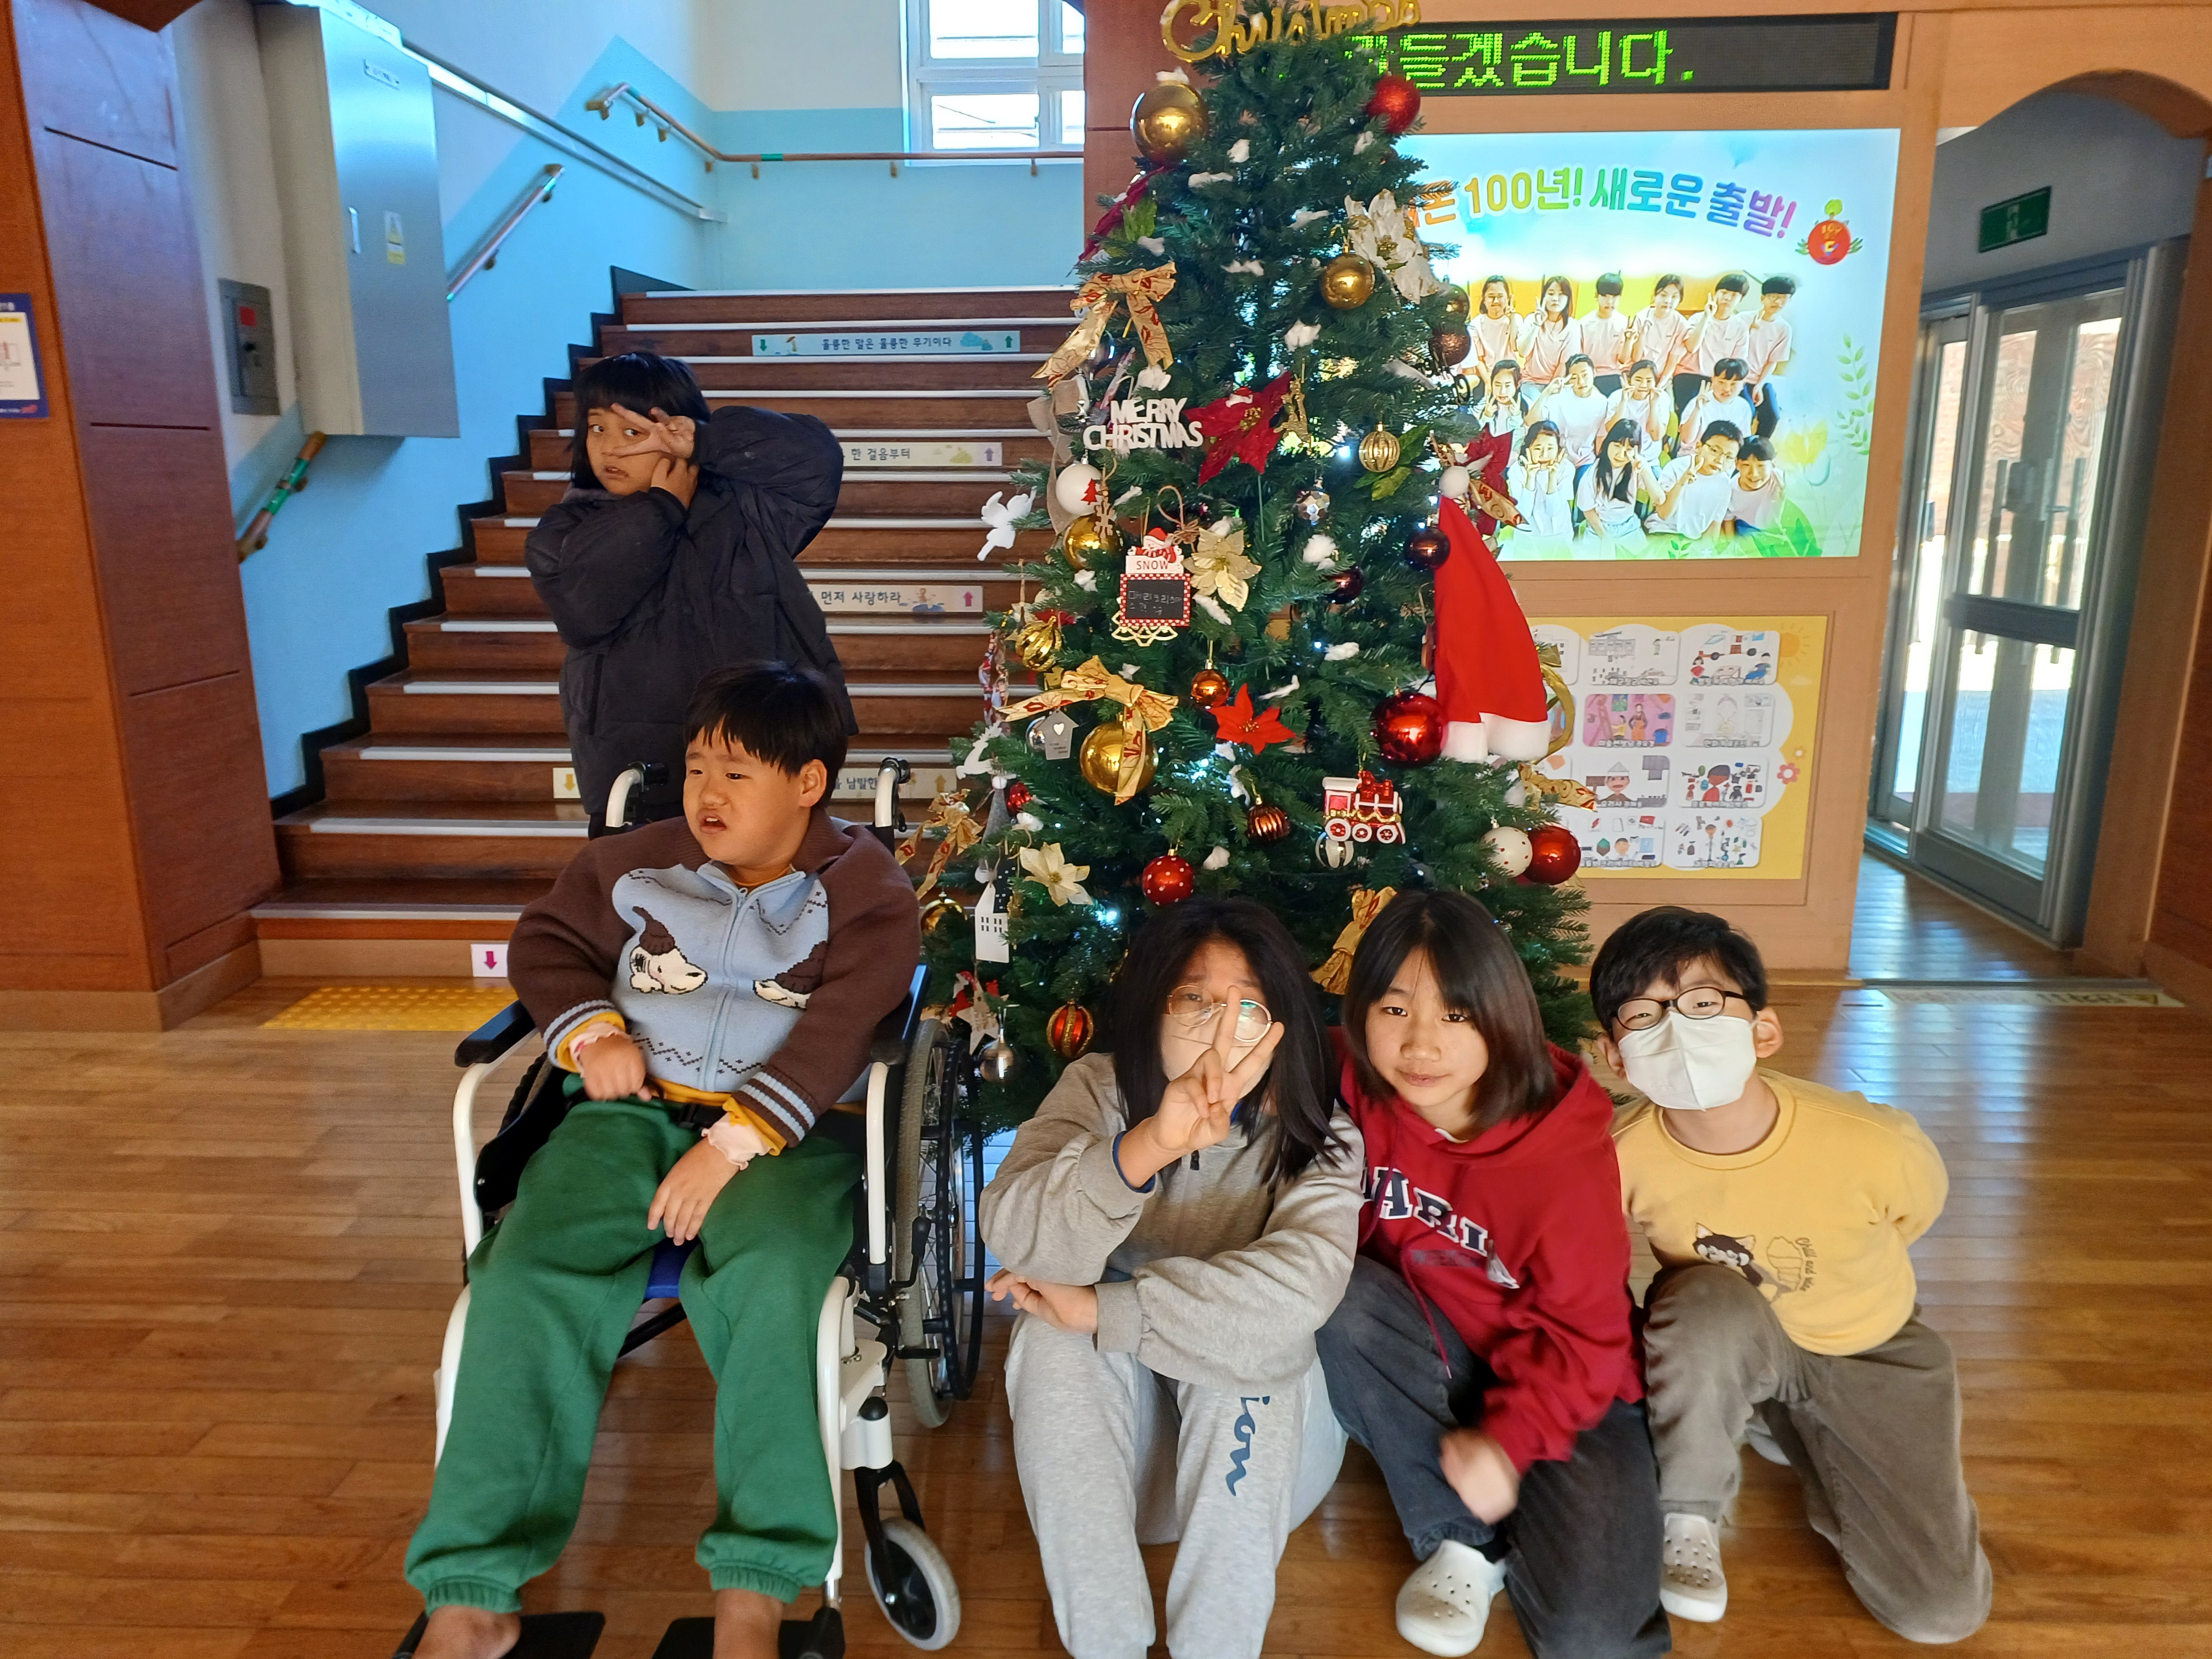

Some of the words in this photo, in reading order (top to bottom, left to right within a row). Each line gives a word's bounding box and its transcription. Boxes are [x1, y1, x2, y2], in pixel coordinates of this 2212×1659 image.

[1464, 166, 1584, 216] 100년!
[1589, 167, 1704, 218] 새로운
[1706, 180, 1798, 239] 출발!
[912, 336, 952, 348] 무기이다
[1110, 397, 1188, 424] MERRY
[1082, 420, 1204, 451] CHRISTMAS
[851, 448, 862, 461] 한
[867, 447, 911, 461] 걸음부터
[1136, 560, 1169, 571] SNOW
[821, 591, 845, 606] 먼저
[852, 591, 902, 606] 사랑하라
